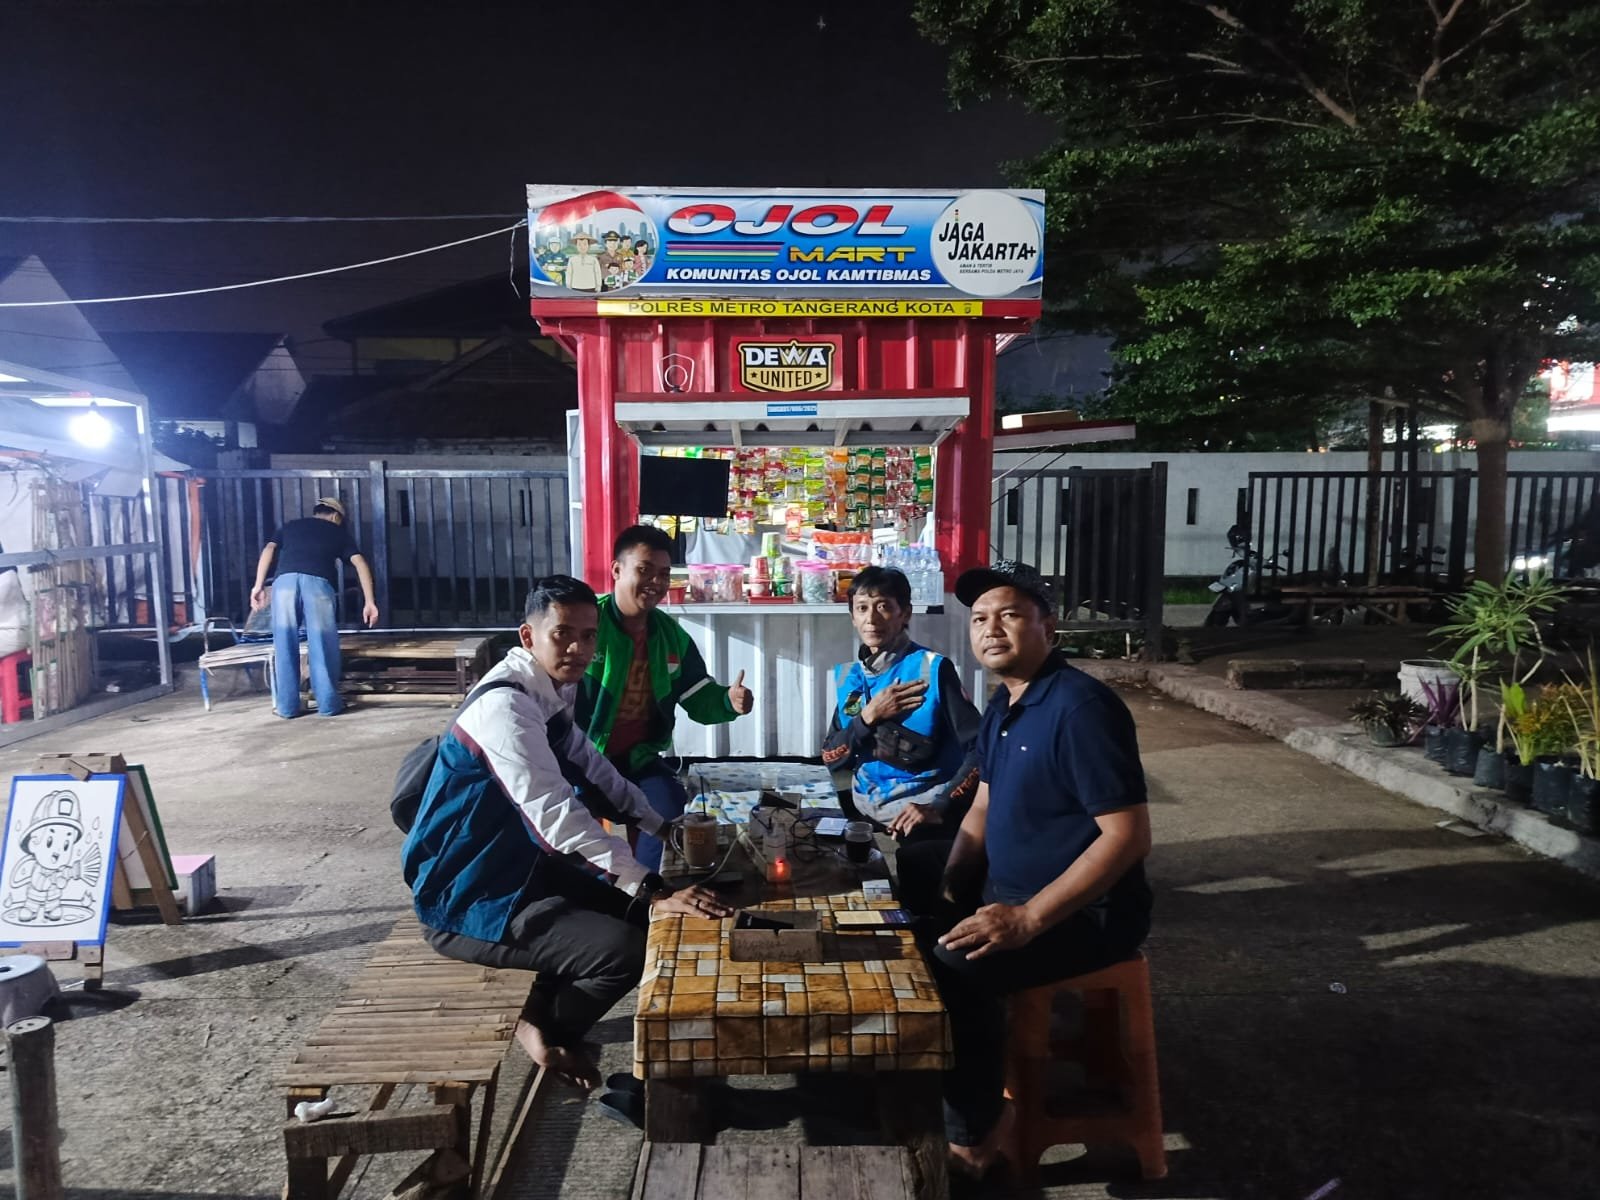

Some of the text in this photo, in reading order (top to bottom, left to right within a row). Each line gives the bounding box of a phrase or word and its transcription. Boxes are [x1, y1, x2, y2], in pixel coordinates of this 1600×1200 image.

[667, 203, 909, 235] OJOL
[939, 221, 984, 242] JAGA
[789, 246, 916, 262] MART
[666, 268, 932, 281] KOMUNITAS OJOL KAMTIBMAS
[628, 302, 955, 314] POLRES METRO TANGERANG KOTA
[743, 346, 827, 366] DEWA
[760, 370, 812, 388] UNITED
